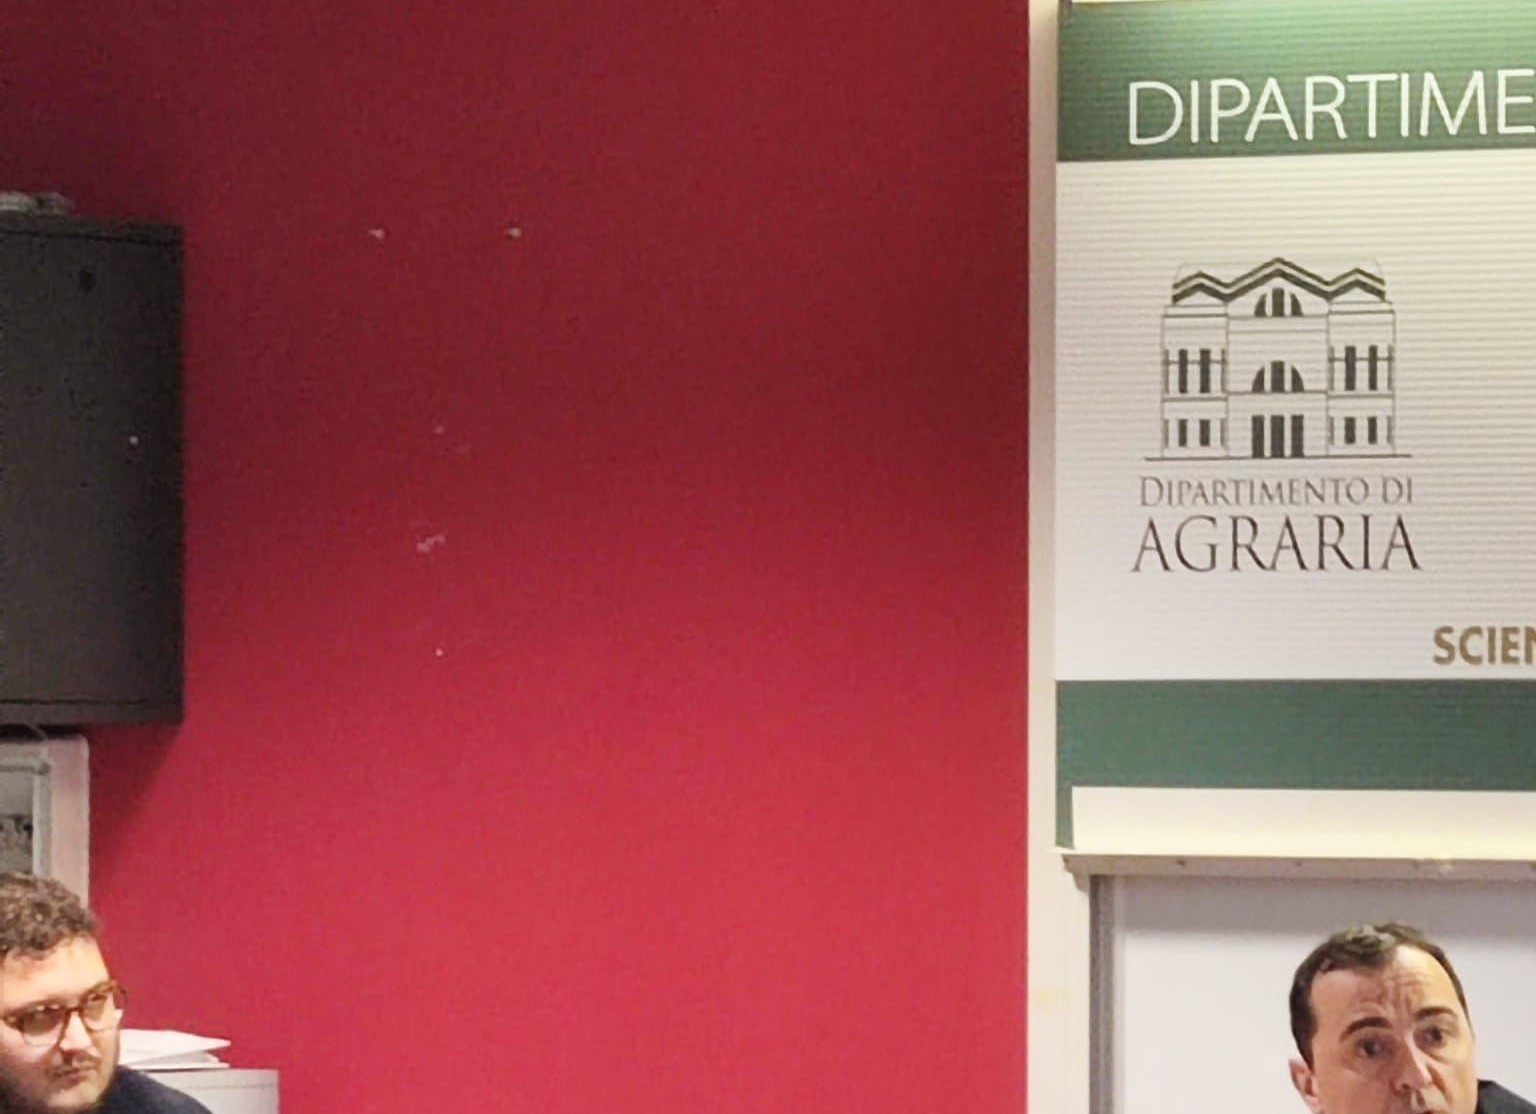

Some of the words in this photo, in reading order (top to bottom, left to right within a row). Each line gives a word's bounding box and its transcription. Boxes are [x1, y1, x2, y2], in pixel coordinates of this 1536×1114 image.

[1139, 475, 1370, 507] DIPARTIMENTO
[1381, 475, 1414, 504] DI
[1131, 513, 1423, 573] AGRARIA
